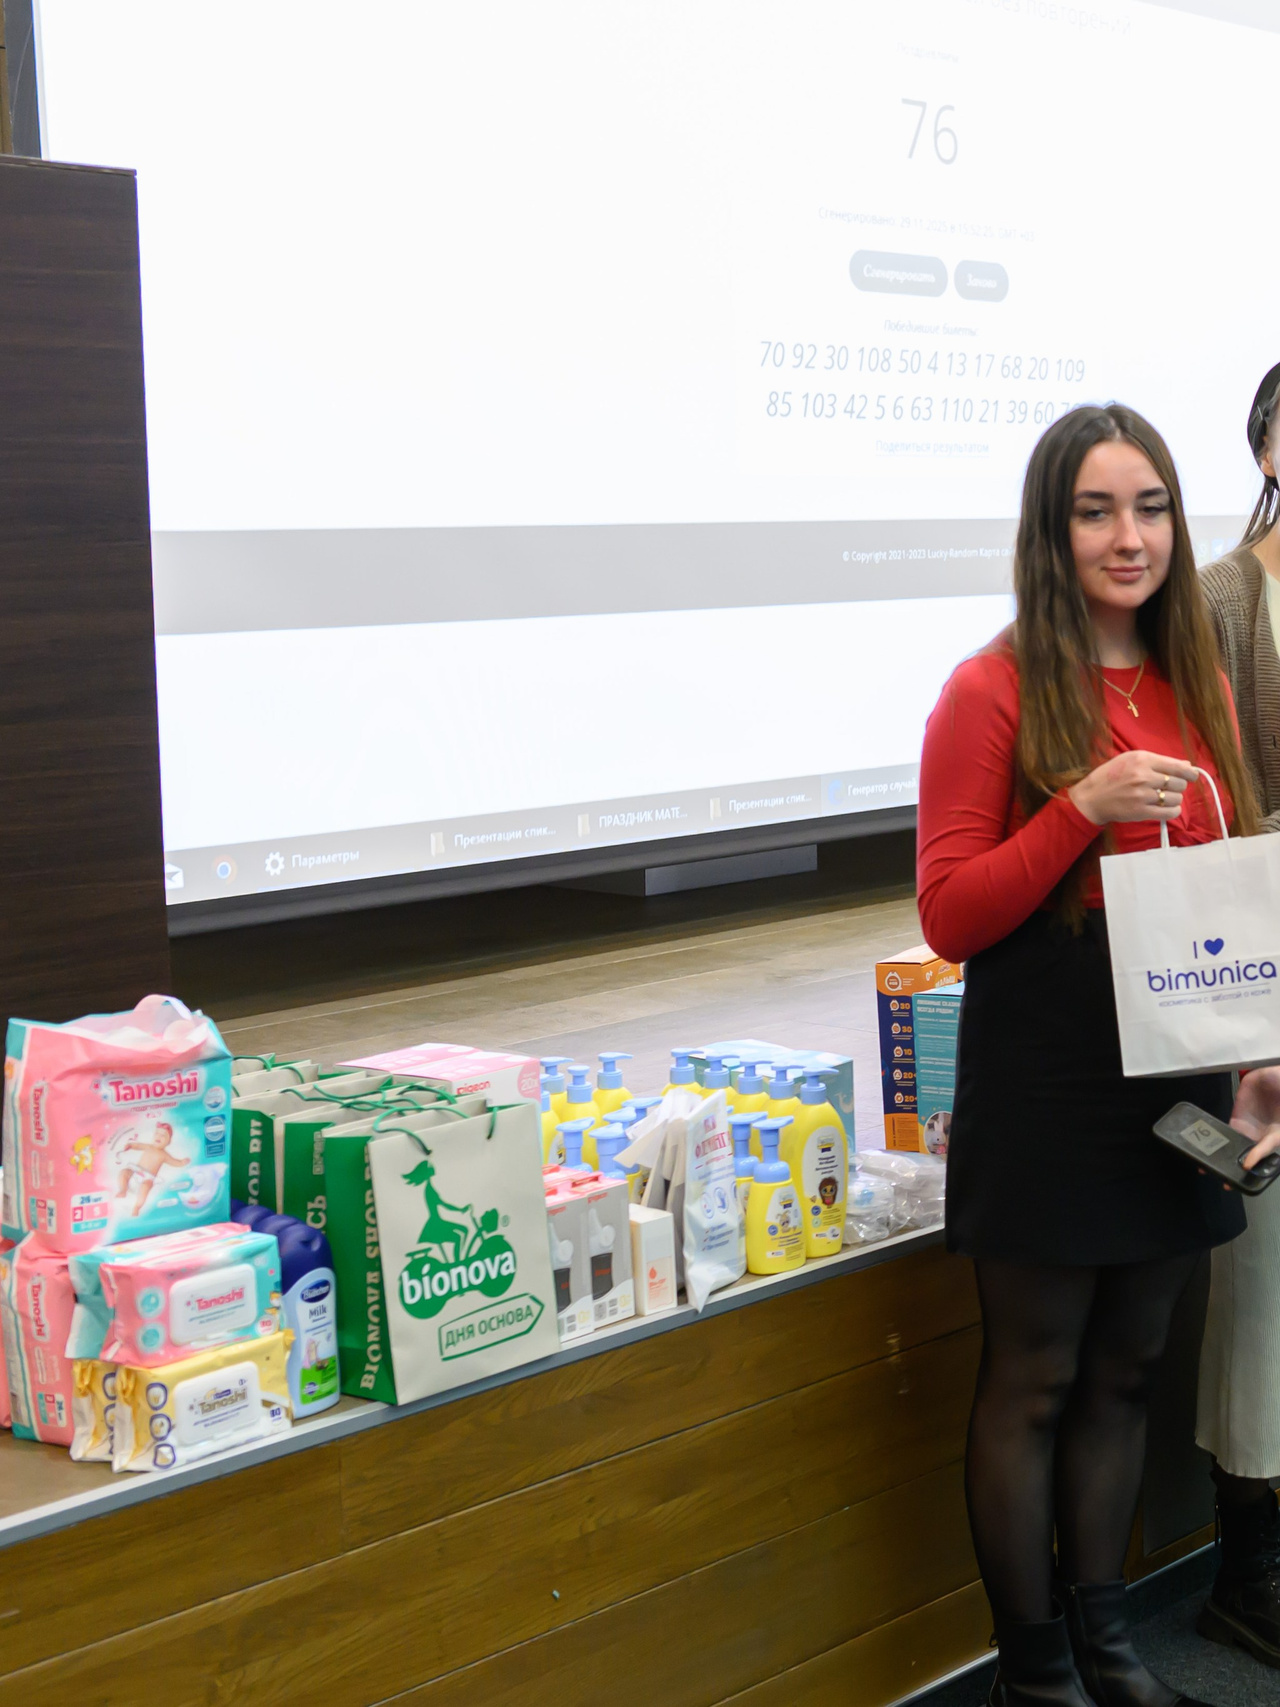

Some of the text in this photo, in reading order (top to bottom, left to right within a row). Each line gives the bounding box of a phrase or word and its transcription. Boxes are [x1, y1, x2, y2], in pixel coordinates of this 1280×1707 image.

[901, 98, 959, 165] 76
[760, 341, 1085, 382] 70 92 30 108 50 4 13 17 68 20 109
[766, 390, 792, 417] 85
[801, 391, 837, 419] 103
[843, 393, 868, 420] 42
[875, 394, 886, 420] 5
[892, 395, 904, 421] 6
[910, 396, 933, 422] 63
[941, 397, 974, 422] 110
[978, 398, 999, 423] 21
[1006, 400, 1028, 424] 39
[1033, 401, 1054, 424] 60
[851, 550, 887, 564] Copyright
[888, 549, 927, 560] 2021-2023
[847, 782, 888, 797] Генератор
[728, 796, 784, 813] Презентации
[599, 809, 653, 829] ПРАЗДНИК
[453, 829, 523, 849] Презентации
[291, 849, 360, 869] Параметры
[1147, 960, 1277, 992] bimunica
[900, 1002, 911, 1010] 30
[901, 1025, 913, 1033] 30
[401, 1249, 516, 1305] bionova
[308, 1304, 328, 1319] Milk
[444, 1304, 535, 1350] ДНЯ ОСНОВА
